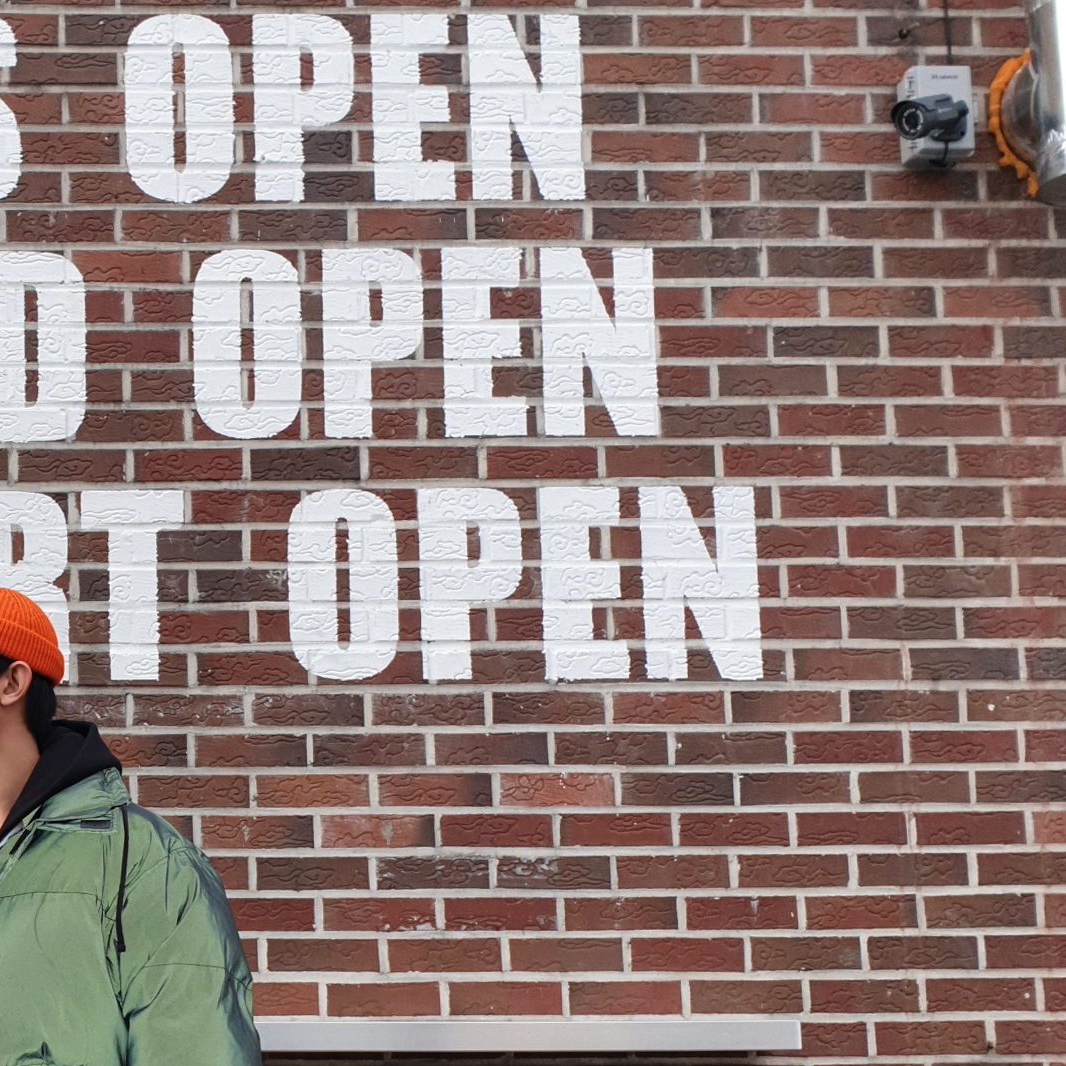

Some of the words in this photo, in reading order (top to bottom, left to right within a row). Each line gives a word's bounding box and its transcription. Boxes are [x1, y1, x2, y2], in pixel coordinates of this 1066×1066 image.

[124, 14, 586, 203] OPEN
[192, 247, 660, 439] OPEN
[287, 486, 764, 681] OPEN
